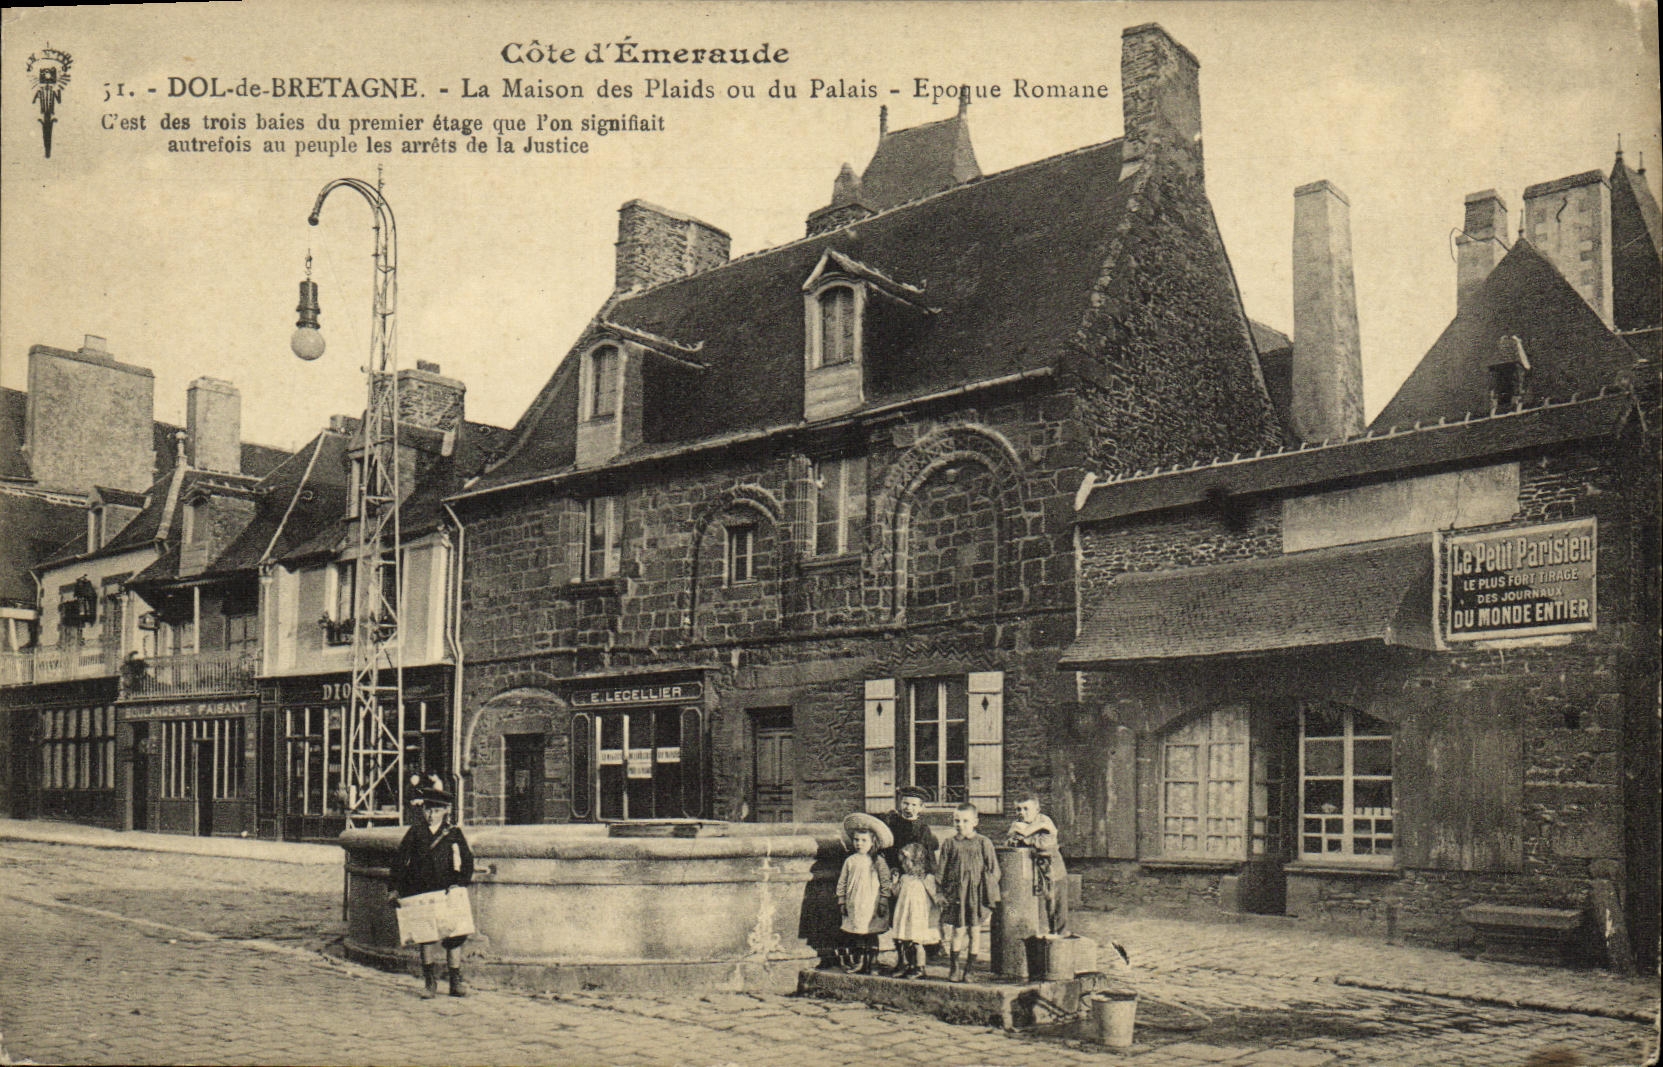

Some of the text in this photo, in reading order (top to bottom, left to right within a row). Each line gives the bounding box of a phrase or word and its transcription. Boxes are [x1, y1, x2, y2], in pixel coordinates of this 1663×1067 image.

[1453, 531, 1592, 576] Le Petit Parisien
[1463, 567, 1579, 592] LE PLUS FORT TIRAGE
[1477, 586, 1563, 605] DES JOURNAUX
[1453, 598, 1590, 629] DU MONDE ENTIER
[198, 701, 247, 715] FAISANT
